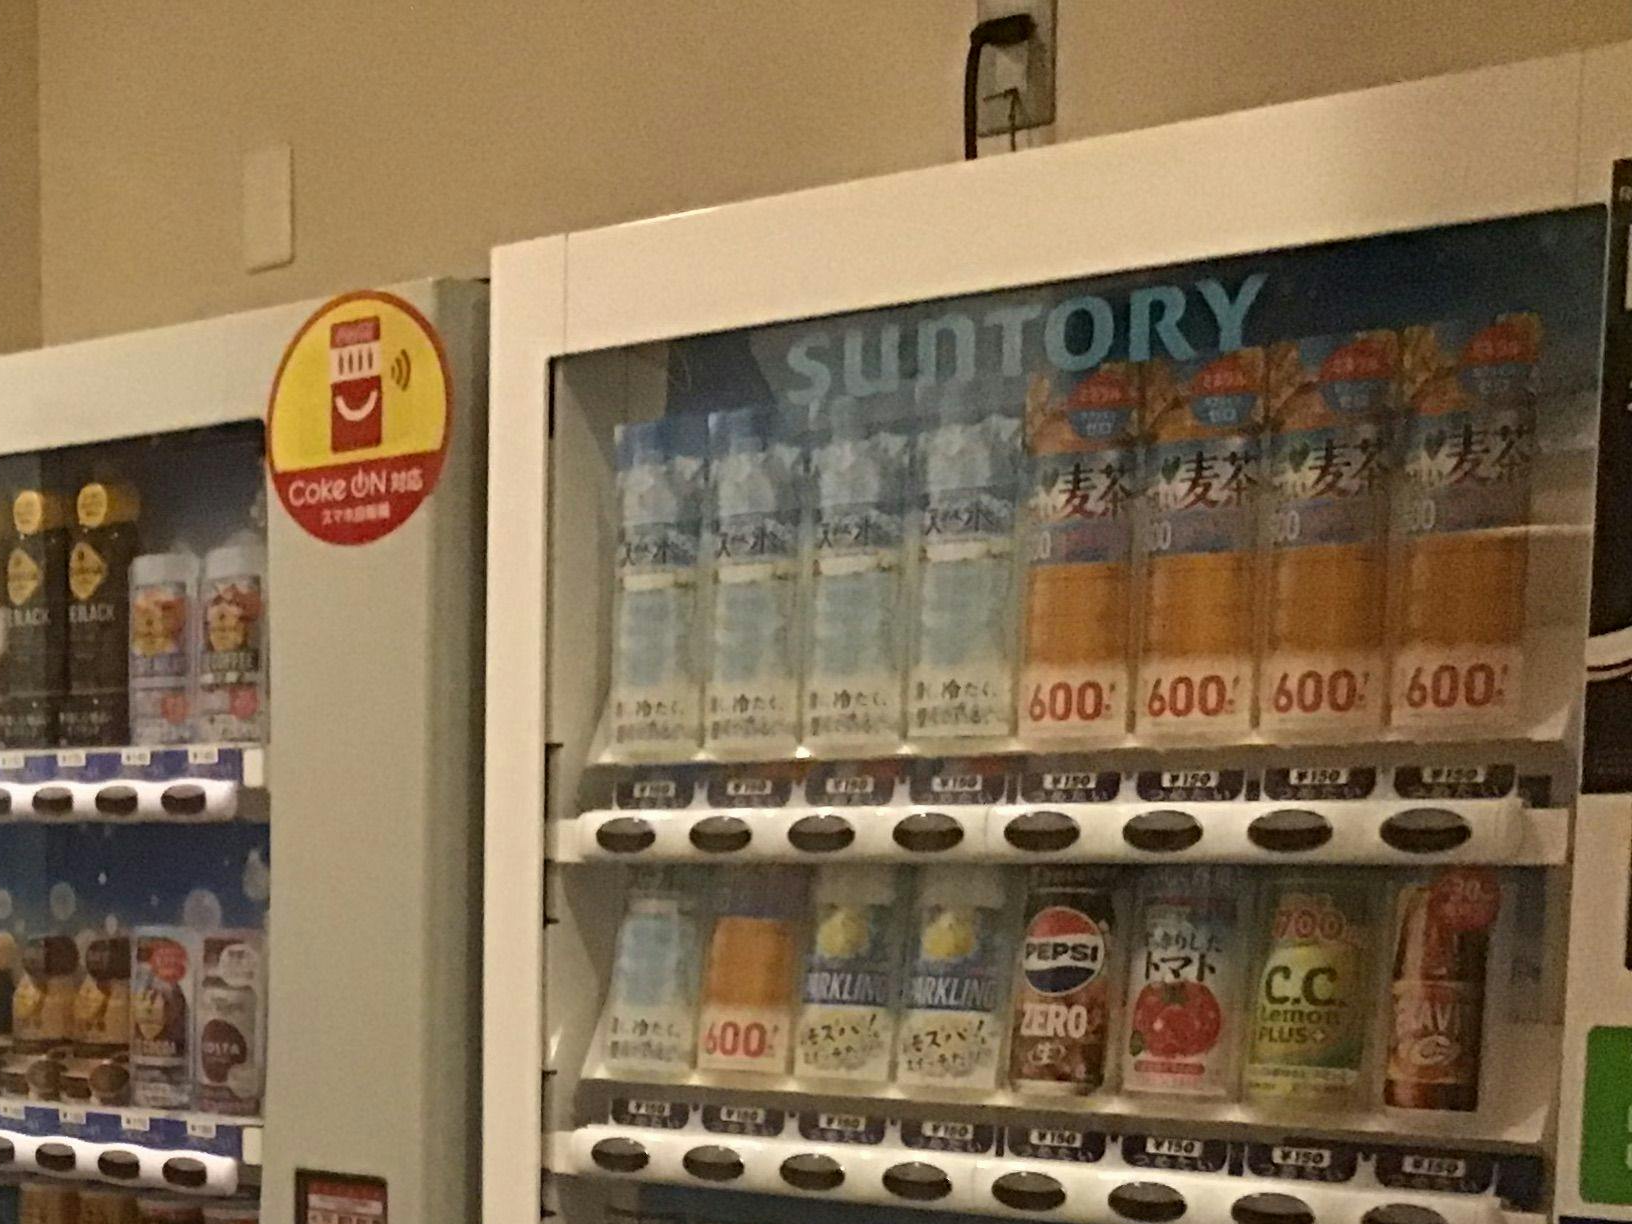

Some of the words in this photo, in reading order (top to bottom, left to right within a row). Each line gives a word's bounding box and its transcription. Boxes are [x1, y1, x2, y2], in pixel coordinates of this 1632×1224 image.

[787, 273, 1266, 405] SUNTORY
[1309, 437, 1390, 498] 麦茶
[1447, 423, 1535, 485] 麦茶
[288, 478, 347, 508] Coke
[350, 466, 388, 499] ON
[1059, 462, 1132, 519] 麦茶
[1182, 450, 1262, 509] 麦茶
[1171, 773, 1211, 787] ¥150
[1298, 769, 1340, 783] ¥150
[1025, 943, 1099, 963] PEPSI
[1144, 950, 1217, 982] トマト
[1020, 1003, 1088, 1040] ZERO
[1257, 1005, 1340, 1026] Lemon
[1154, 1138, 1195, 1154] ¥150
[1281, 1150, 1324, 1164] ¥150
